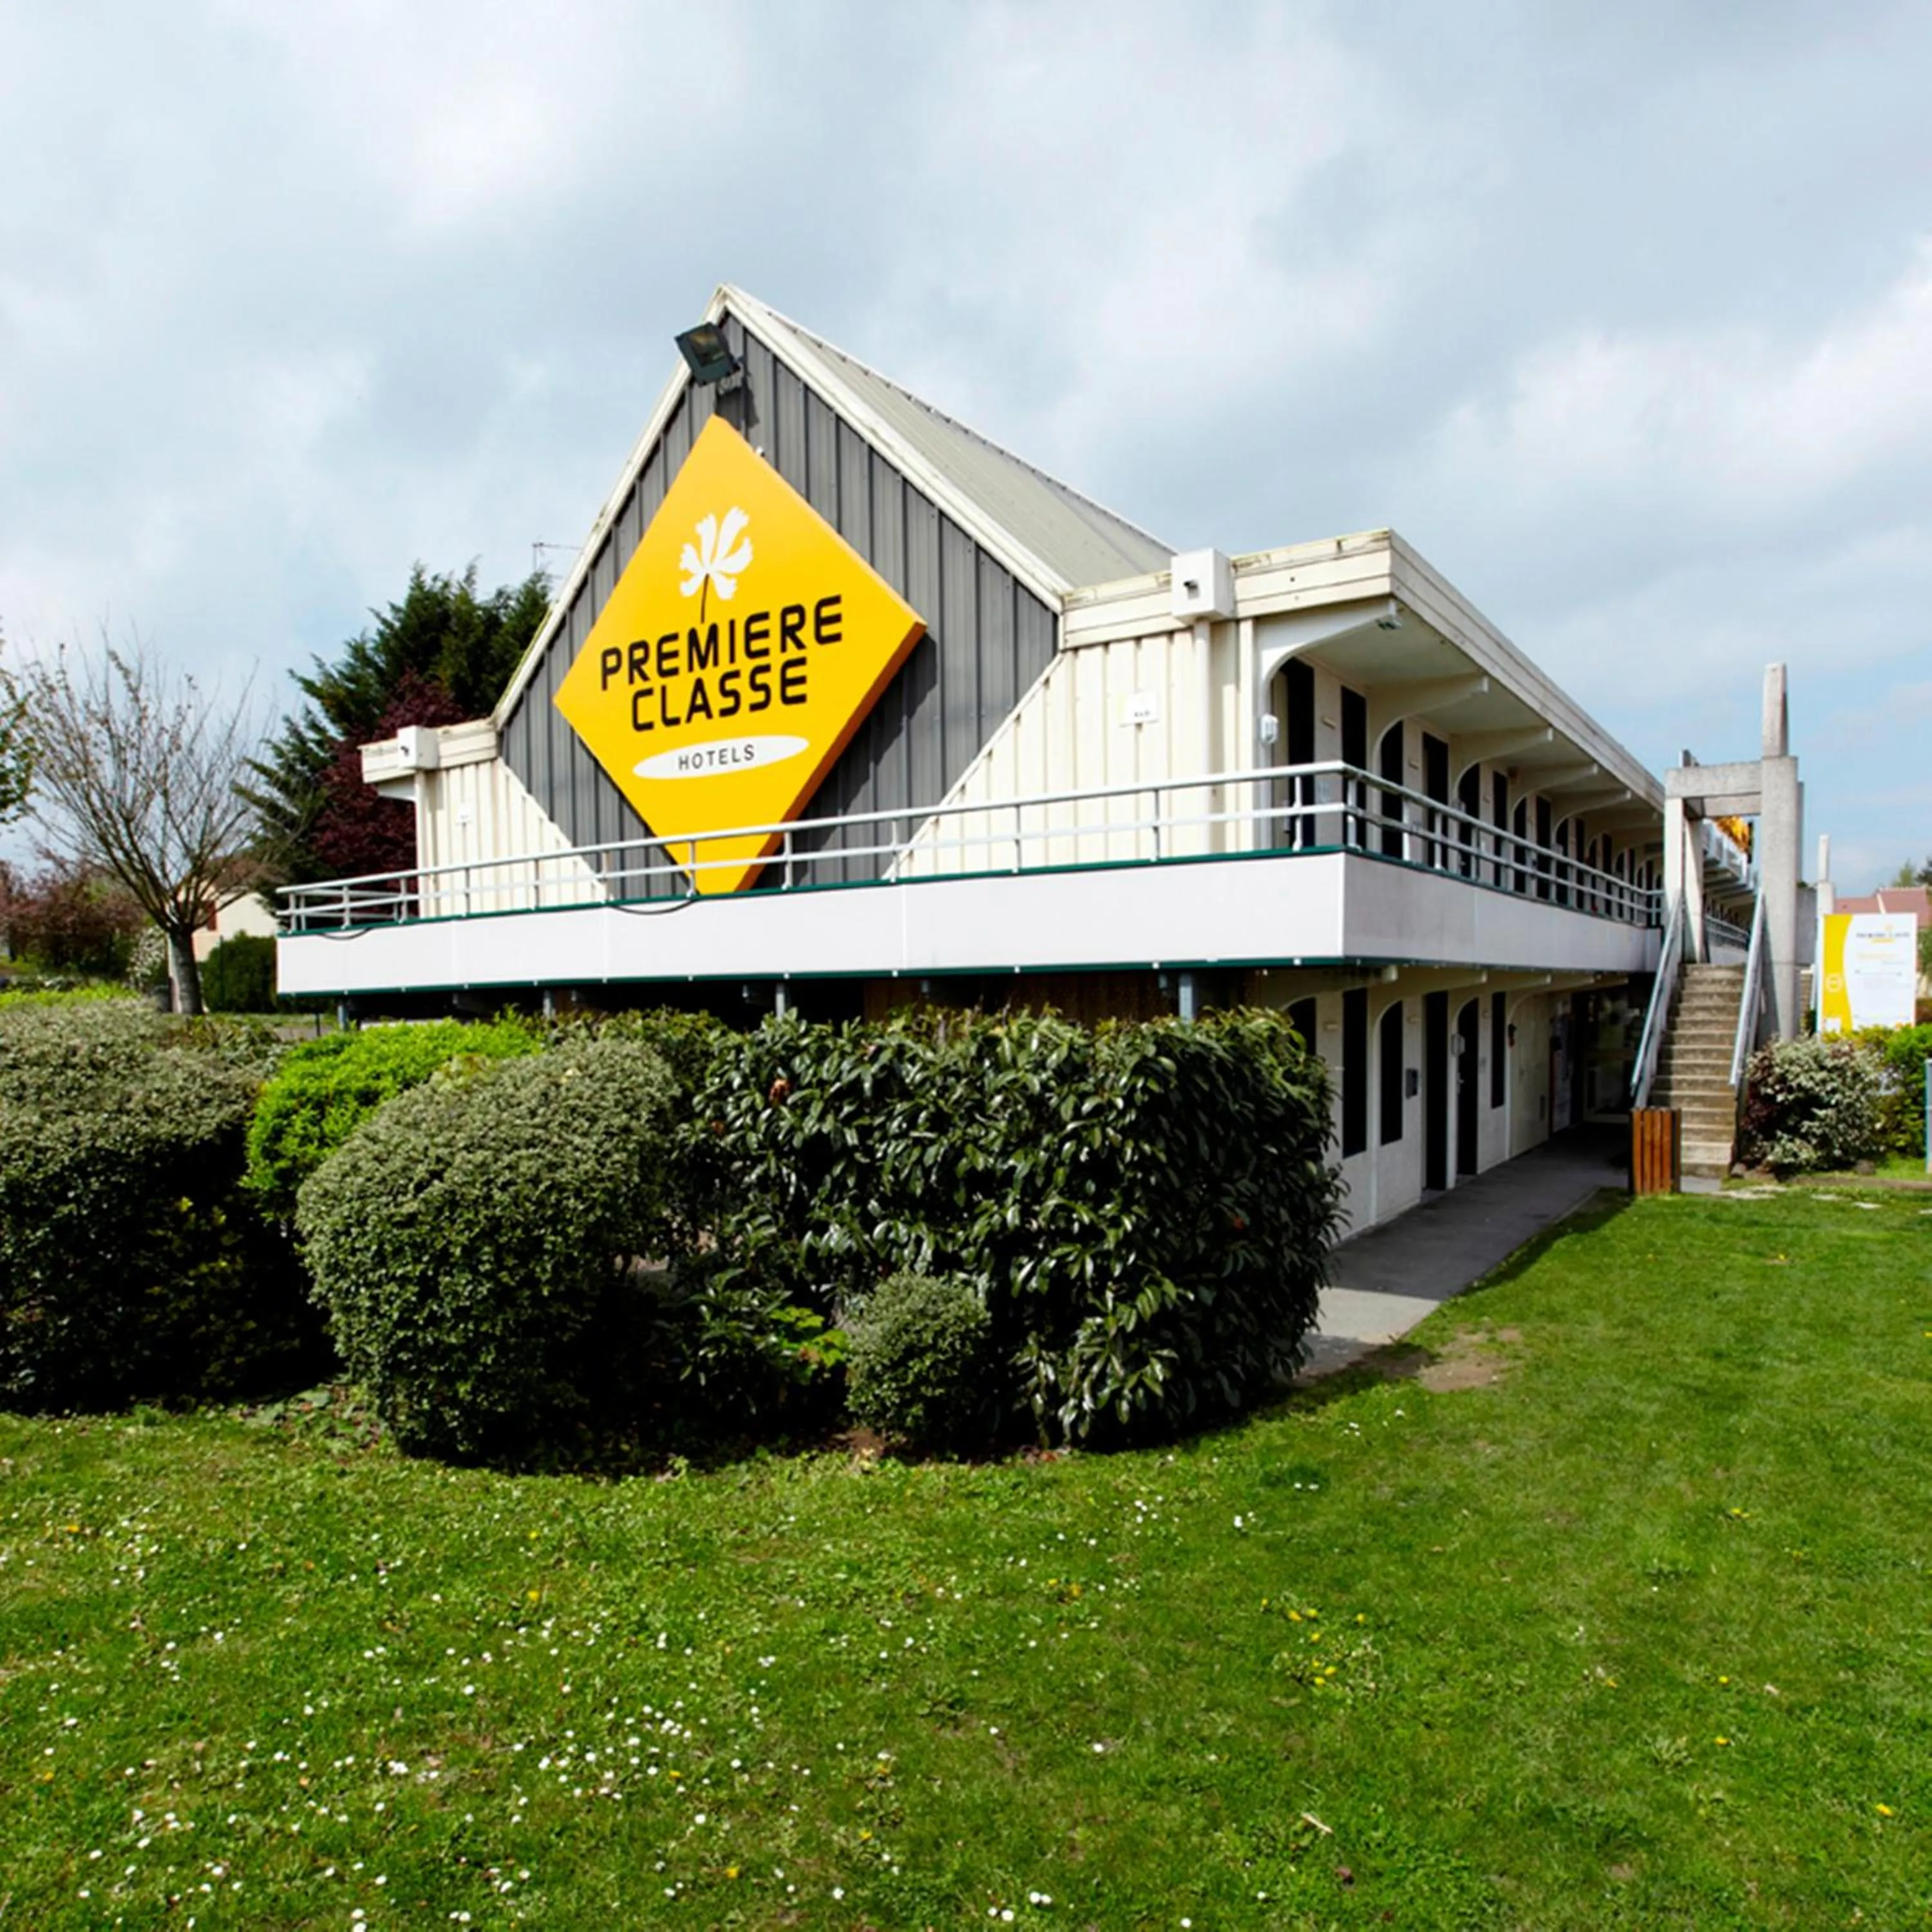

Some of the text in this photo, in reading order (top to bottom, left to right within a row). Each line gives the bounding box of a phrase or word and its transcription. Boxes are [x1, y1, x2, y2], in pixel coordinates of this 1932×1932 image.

[601, 594, 842, 692] PREMIERE
[631, 656, 808, 733] CLASSE
[678, 744, 755, 770] HOTELS
